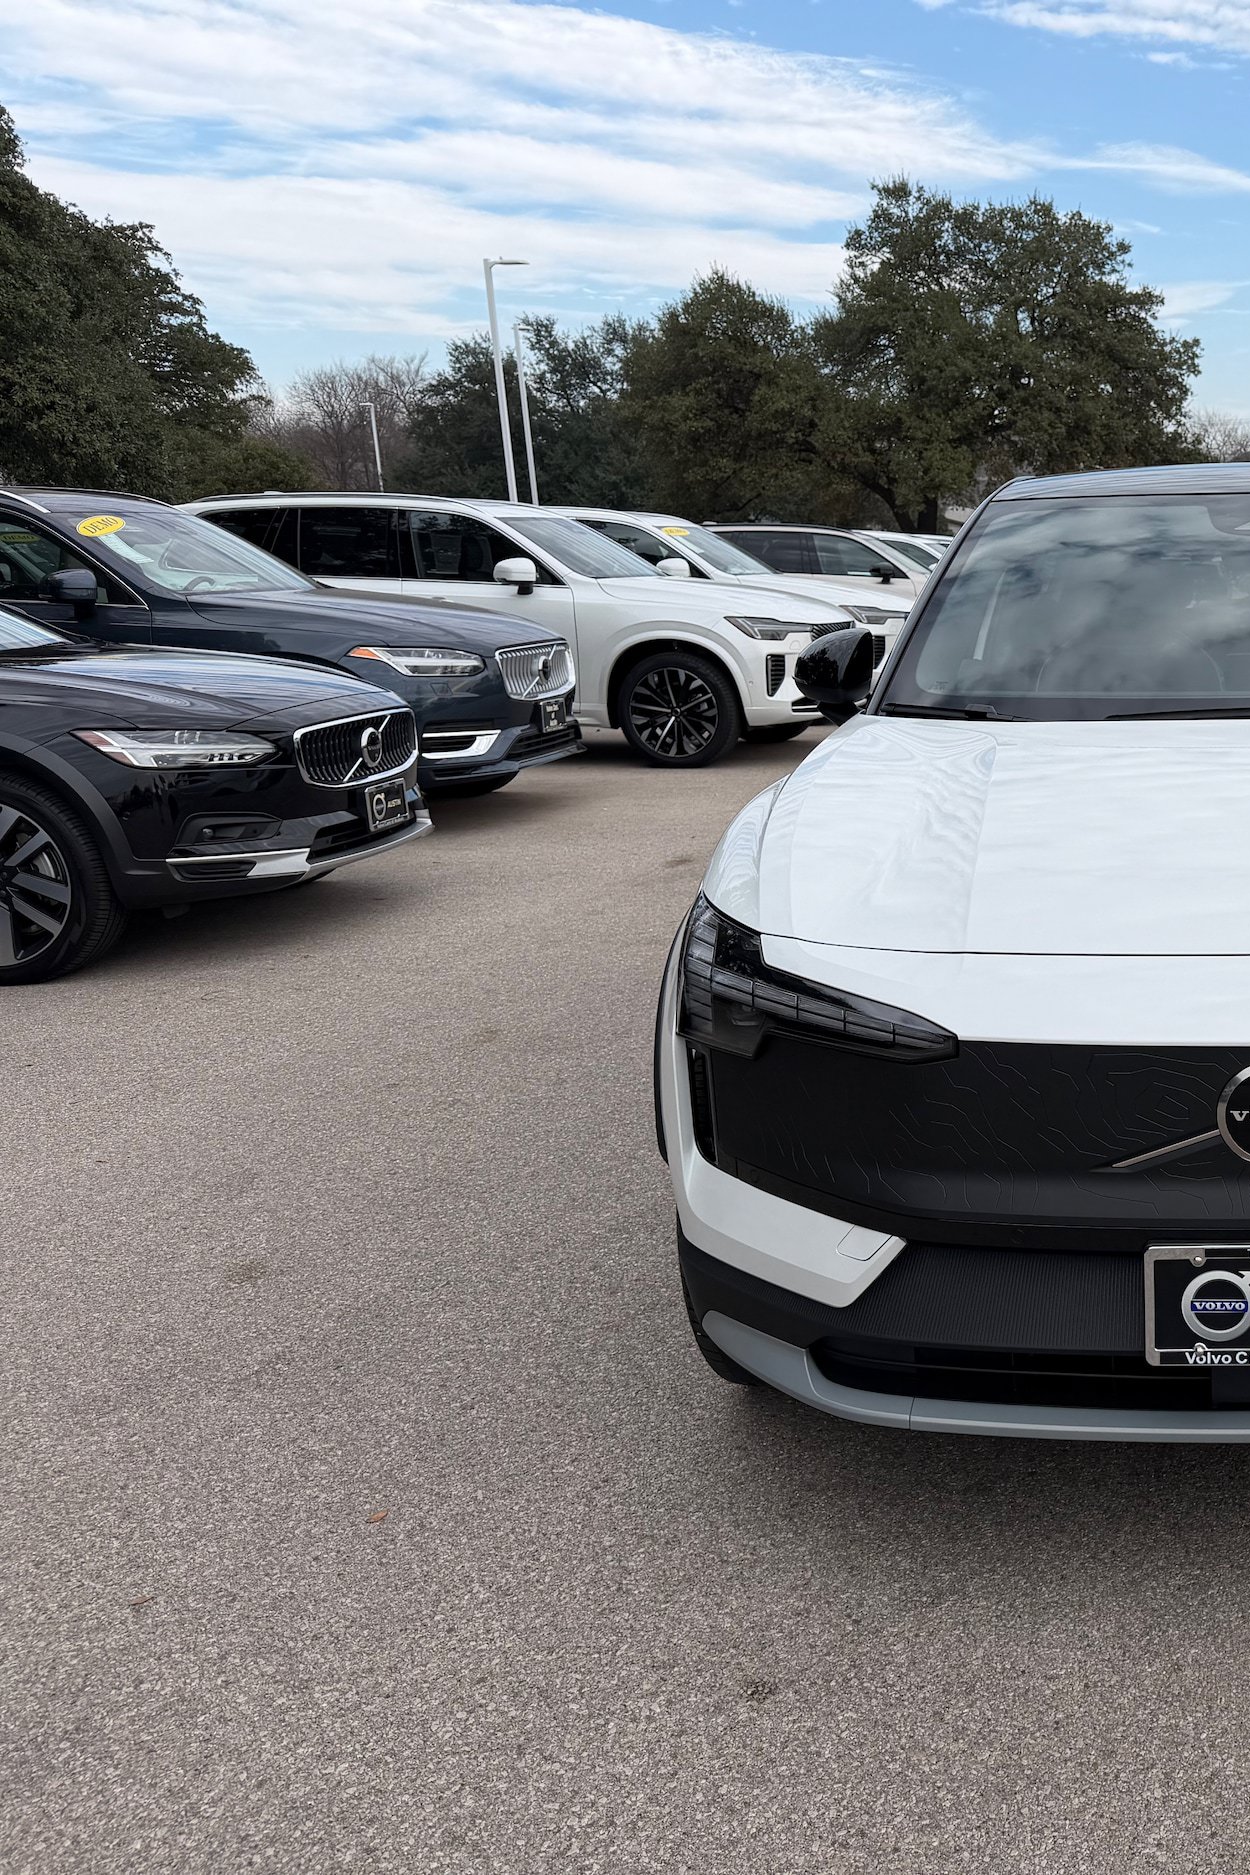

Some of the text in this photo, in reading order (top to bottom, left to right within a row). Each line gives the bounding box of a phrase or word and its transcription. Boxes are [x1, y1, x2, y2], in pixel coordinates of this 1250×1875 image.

[83, 516, 119, 534] DEMO
[1192, 1301, 1246, 1311] VOLVO
[1185, 1351, 1232, 1364] Volvo
